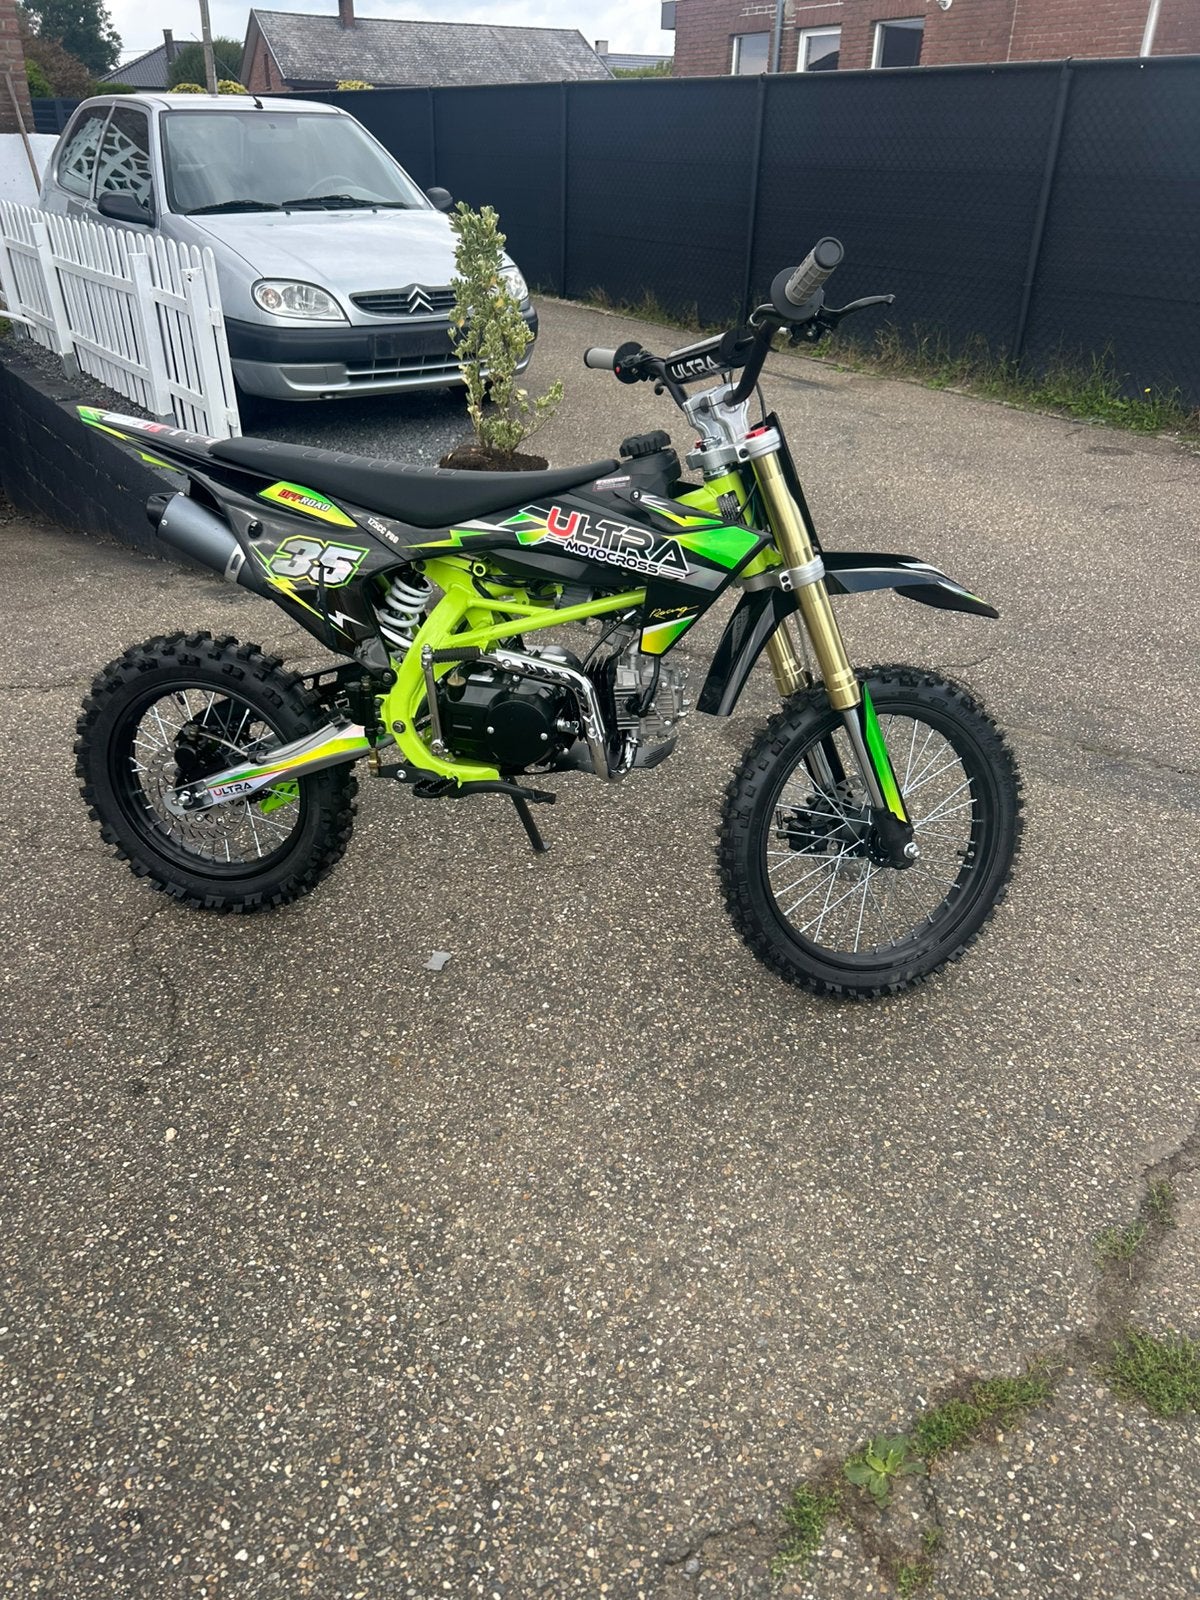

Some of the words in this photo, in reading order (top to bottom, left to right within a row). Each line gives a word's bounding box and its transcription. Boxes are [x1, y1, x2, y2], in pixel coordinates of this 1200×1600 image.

[671, 355, 720, 379] ULTRA
[547, 506, 689, 572] ULTRA
[270, 539, 362, 584] 35
[563, 539, 660, 576] MOTOCROSS
[649, 605, 699, 619] Racing
[213, 782, 253, 796] ULTRA
